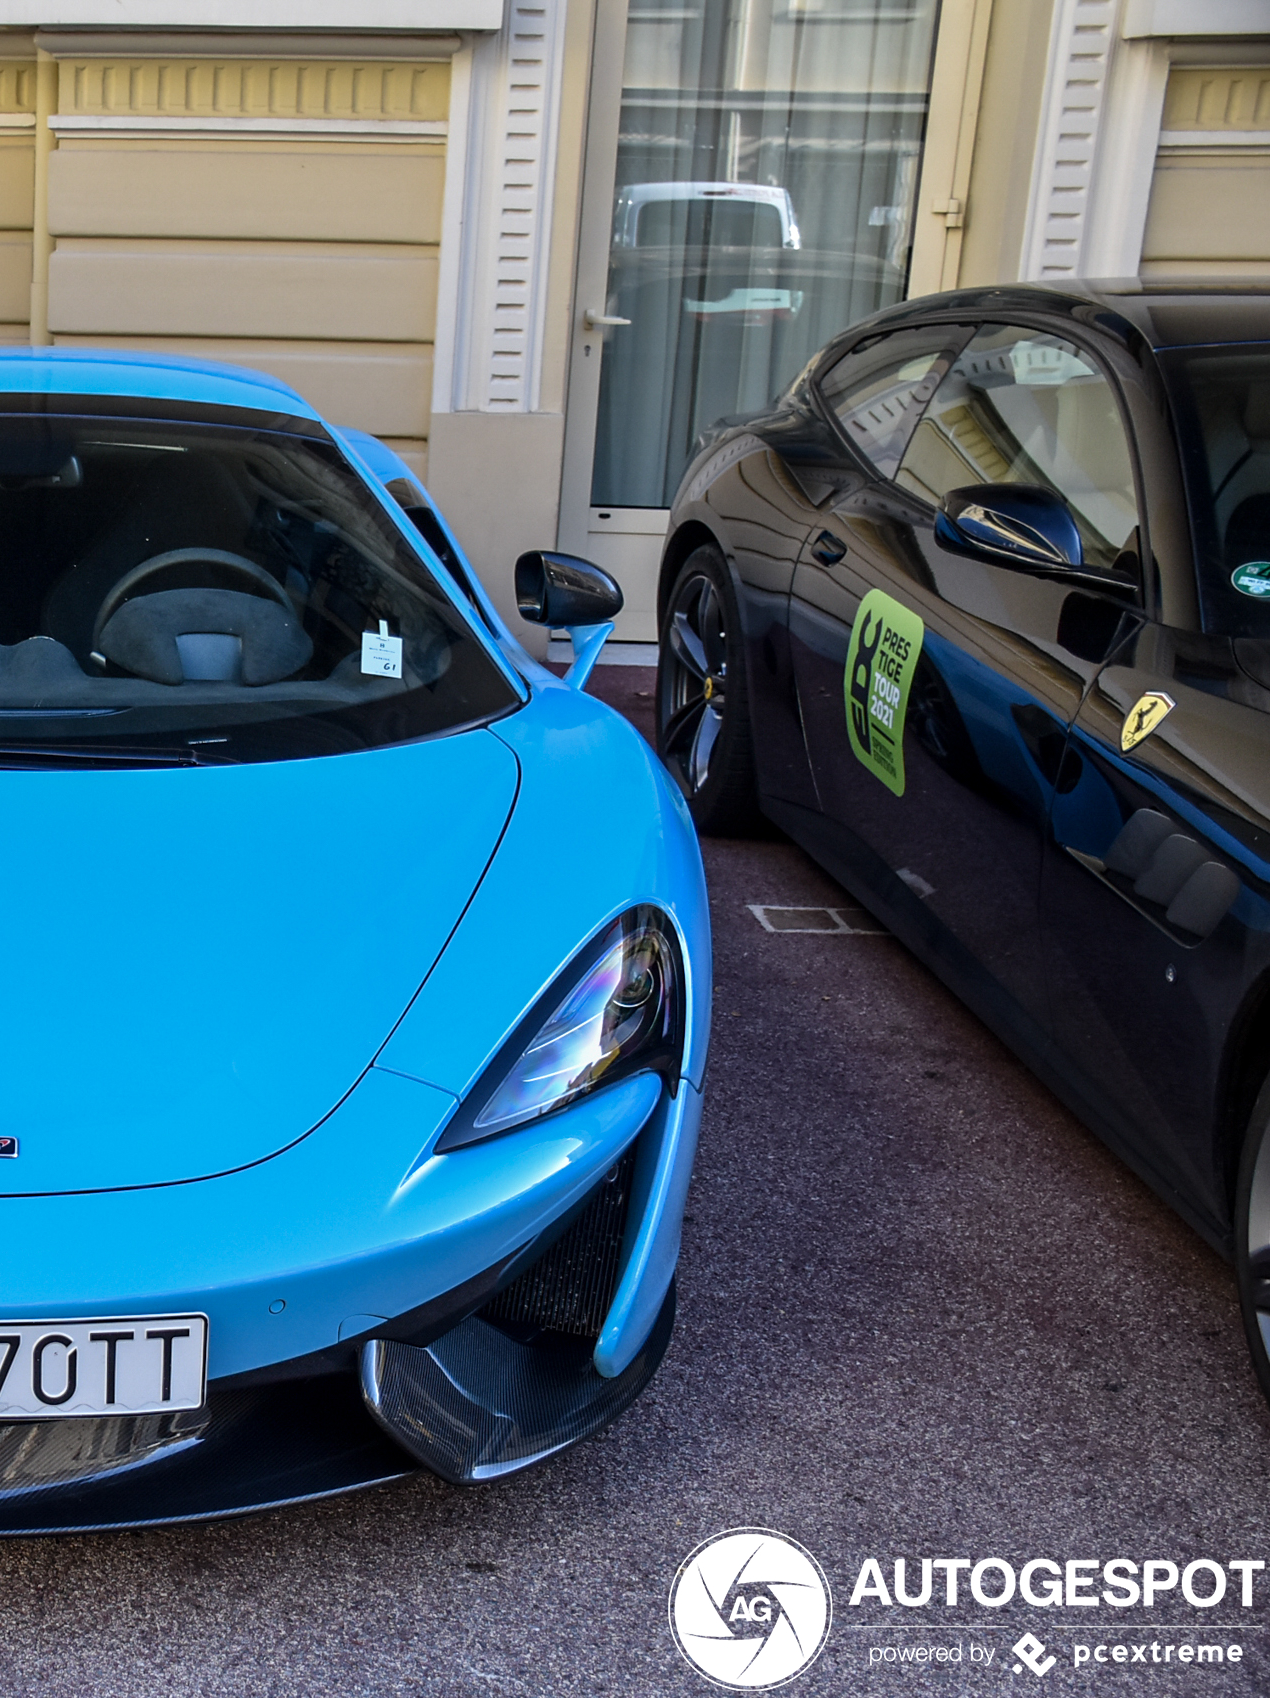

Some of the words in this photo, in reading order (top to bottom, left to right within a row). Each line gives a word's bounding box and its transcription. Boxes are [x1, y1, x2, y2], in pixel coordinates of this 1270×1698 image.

[882, 626, 911, 662] PRES
[879, 649, 903, 684] TIGE
[874, 672, 900, 710] TOUR
[871, 696, 894, 730] 2021
